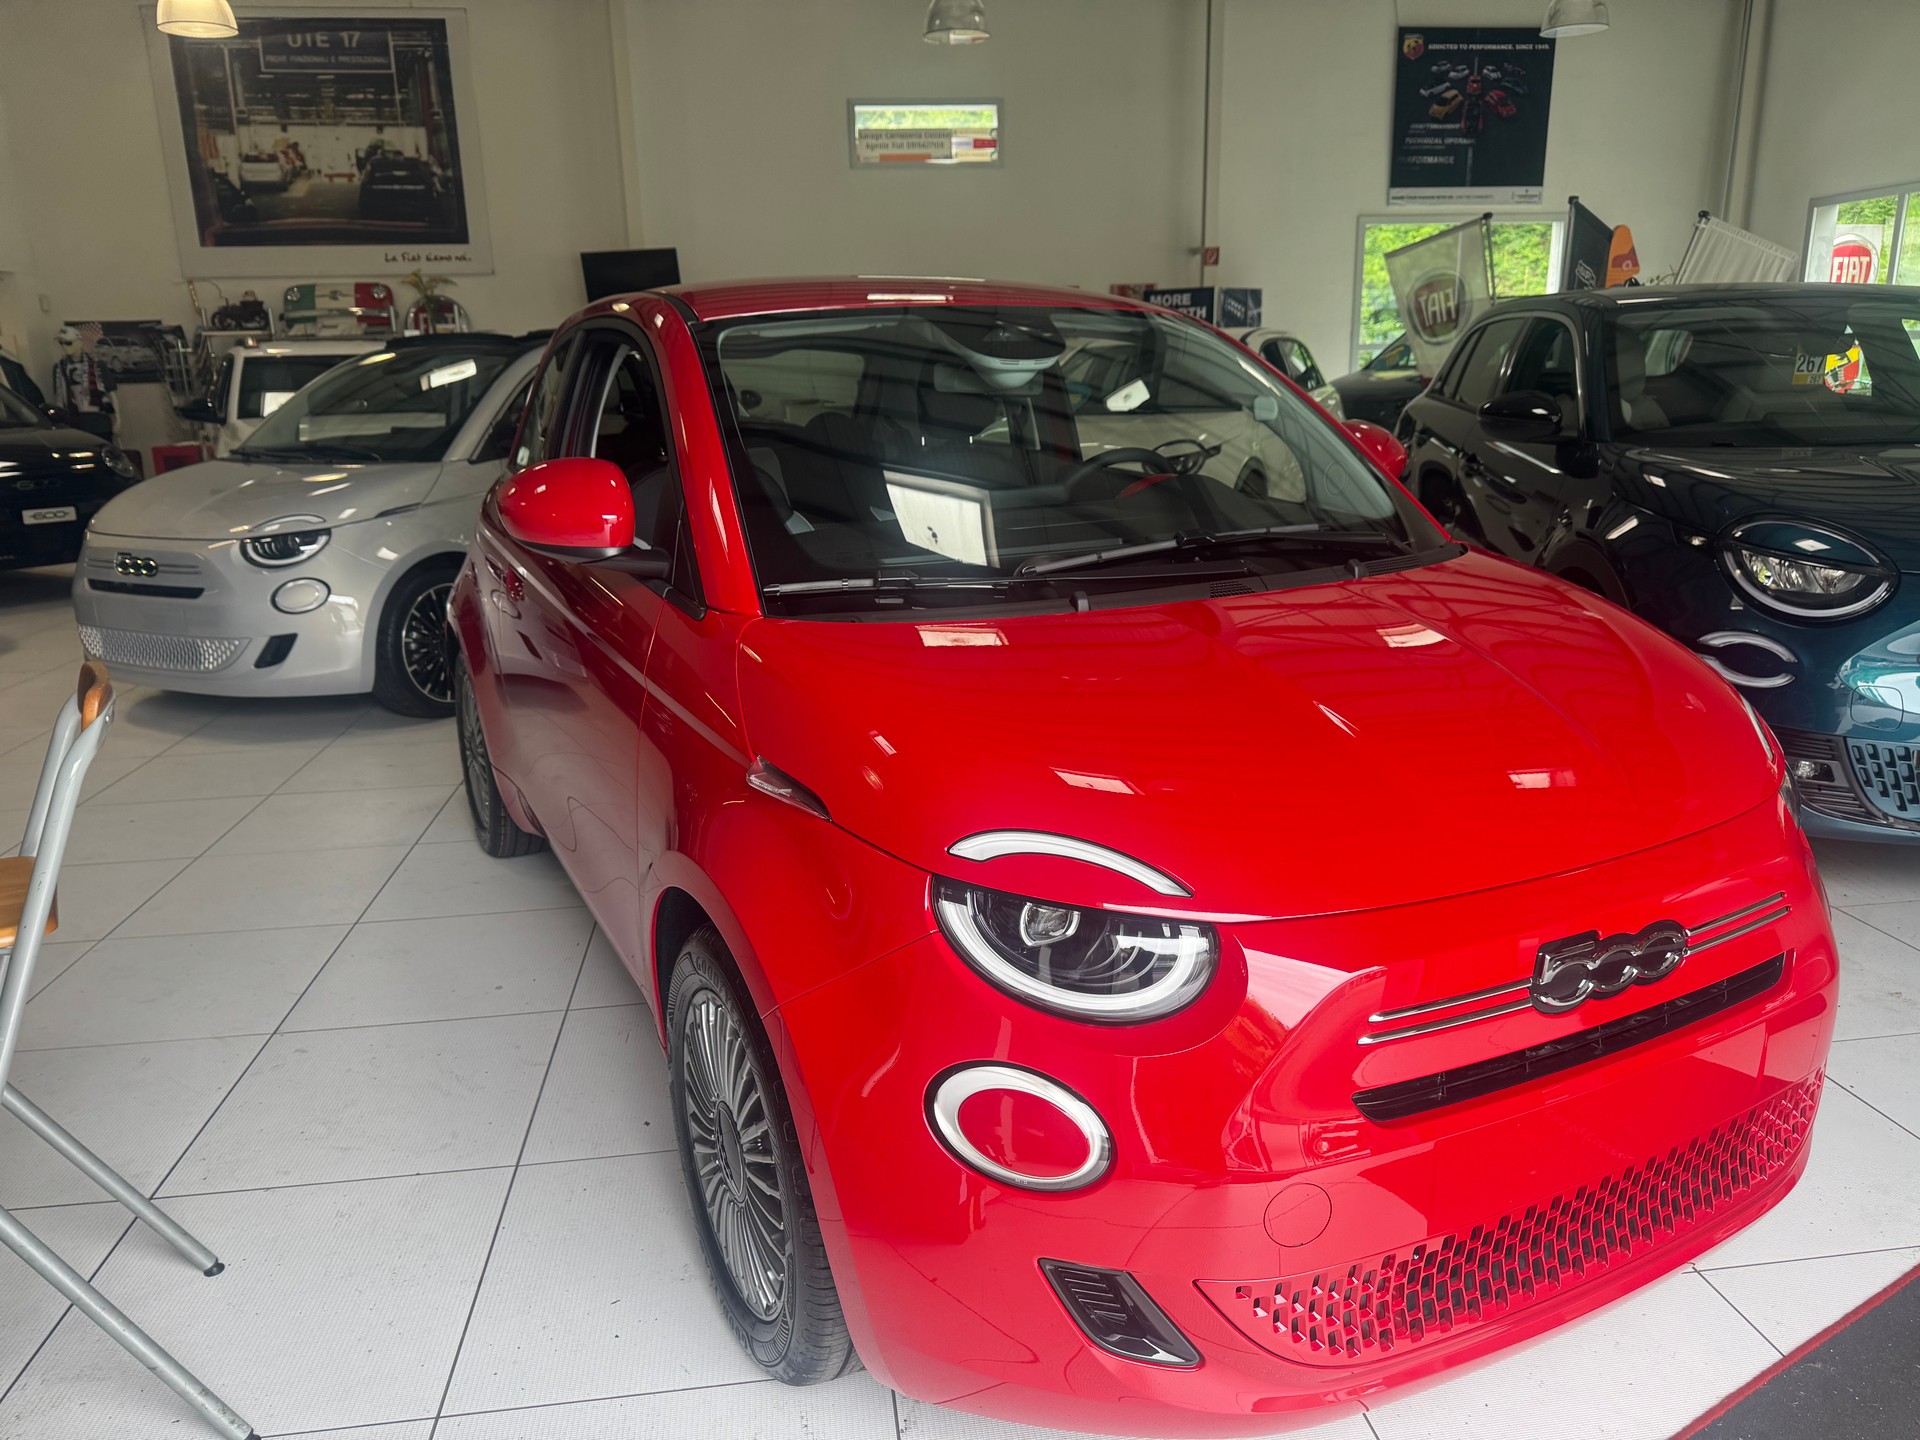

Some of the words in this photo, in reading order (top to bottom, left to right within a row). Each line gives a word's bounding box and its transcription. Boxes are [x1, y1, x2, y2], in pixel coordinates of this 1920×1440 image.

[1830, 256, 1871, 284] FIAT
[1150, 292, 1191, 306] MORE
[1796, 354, 1825, 373] 267
[114, 552, 158, 577] 500
[1531, 920, 1688, 1013] 500
